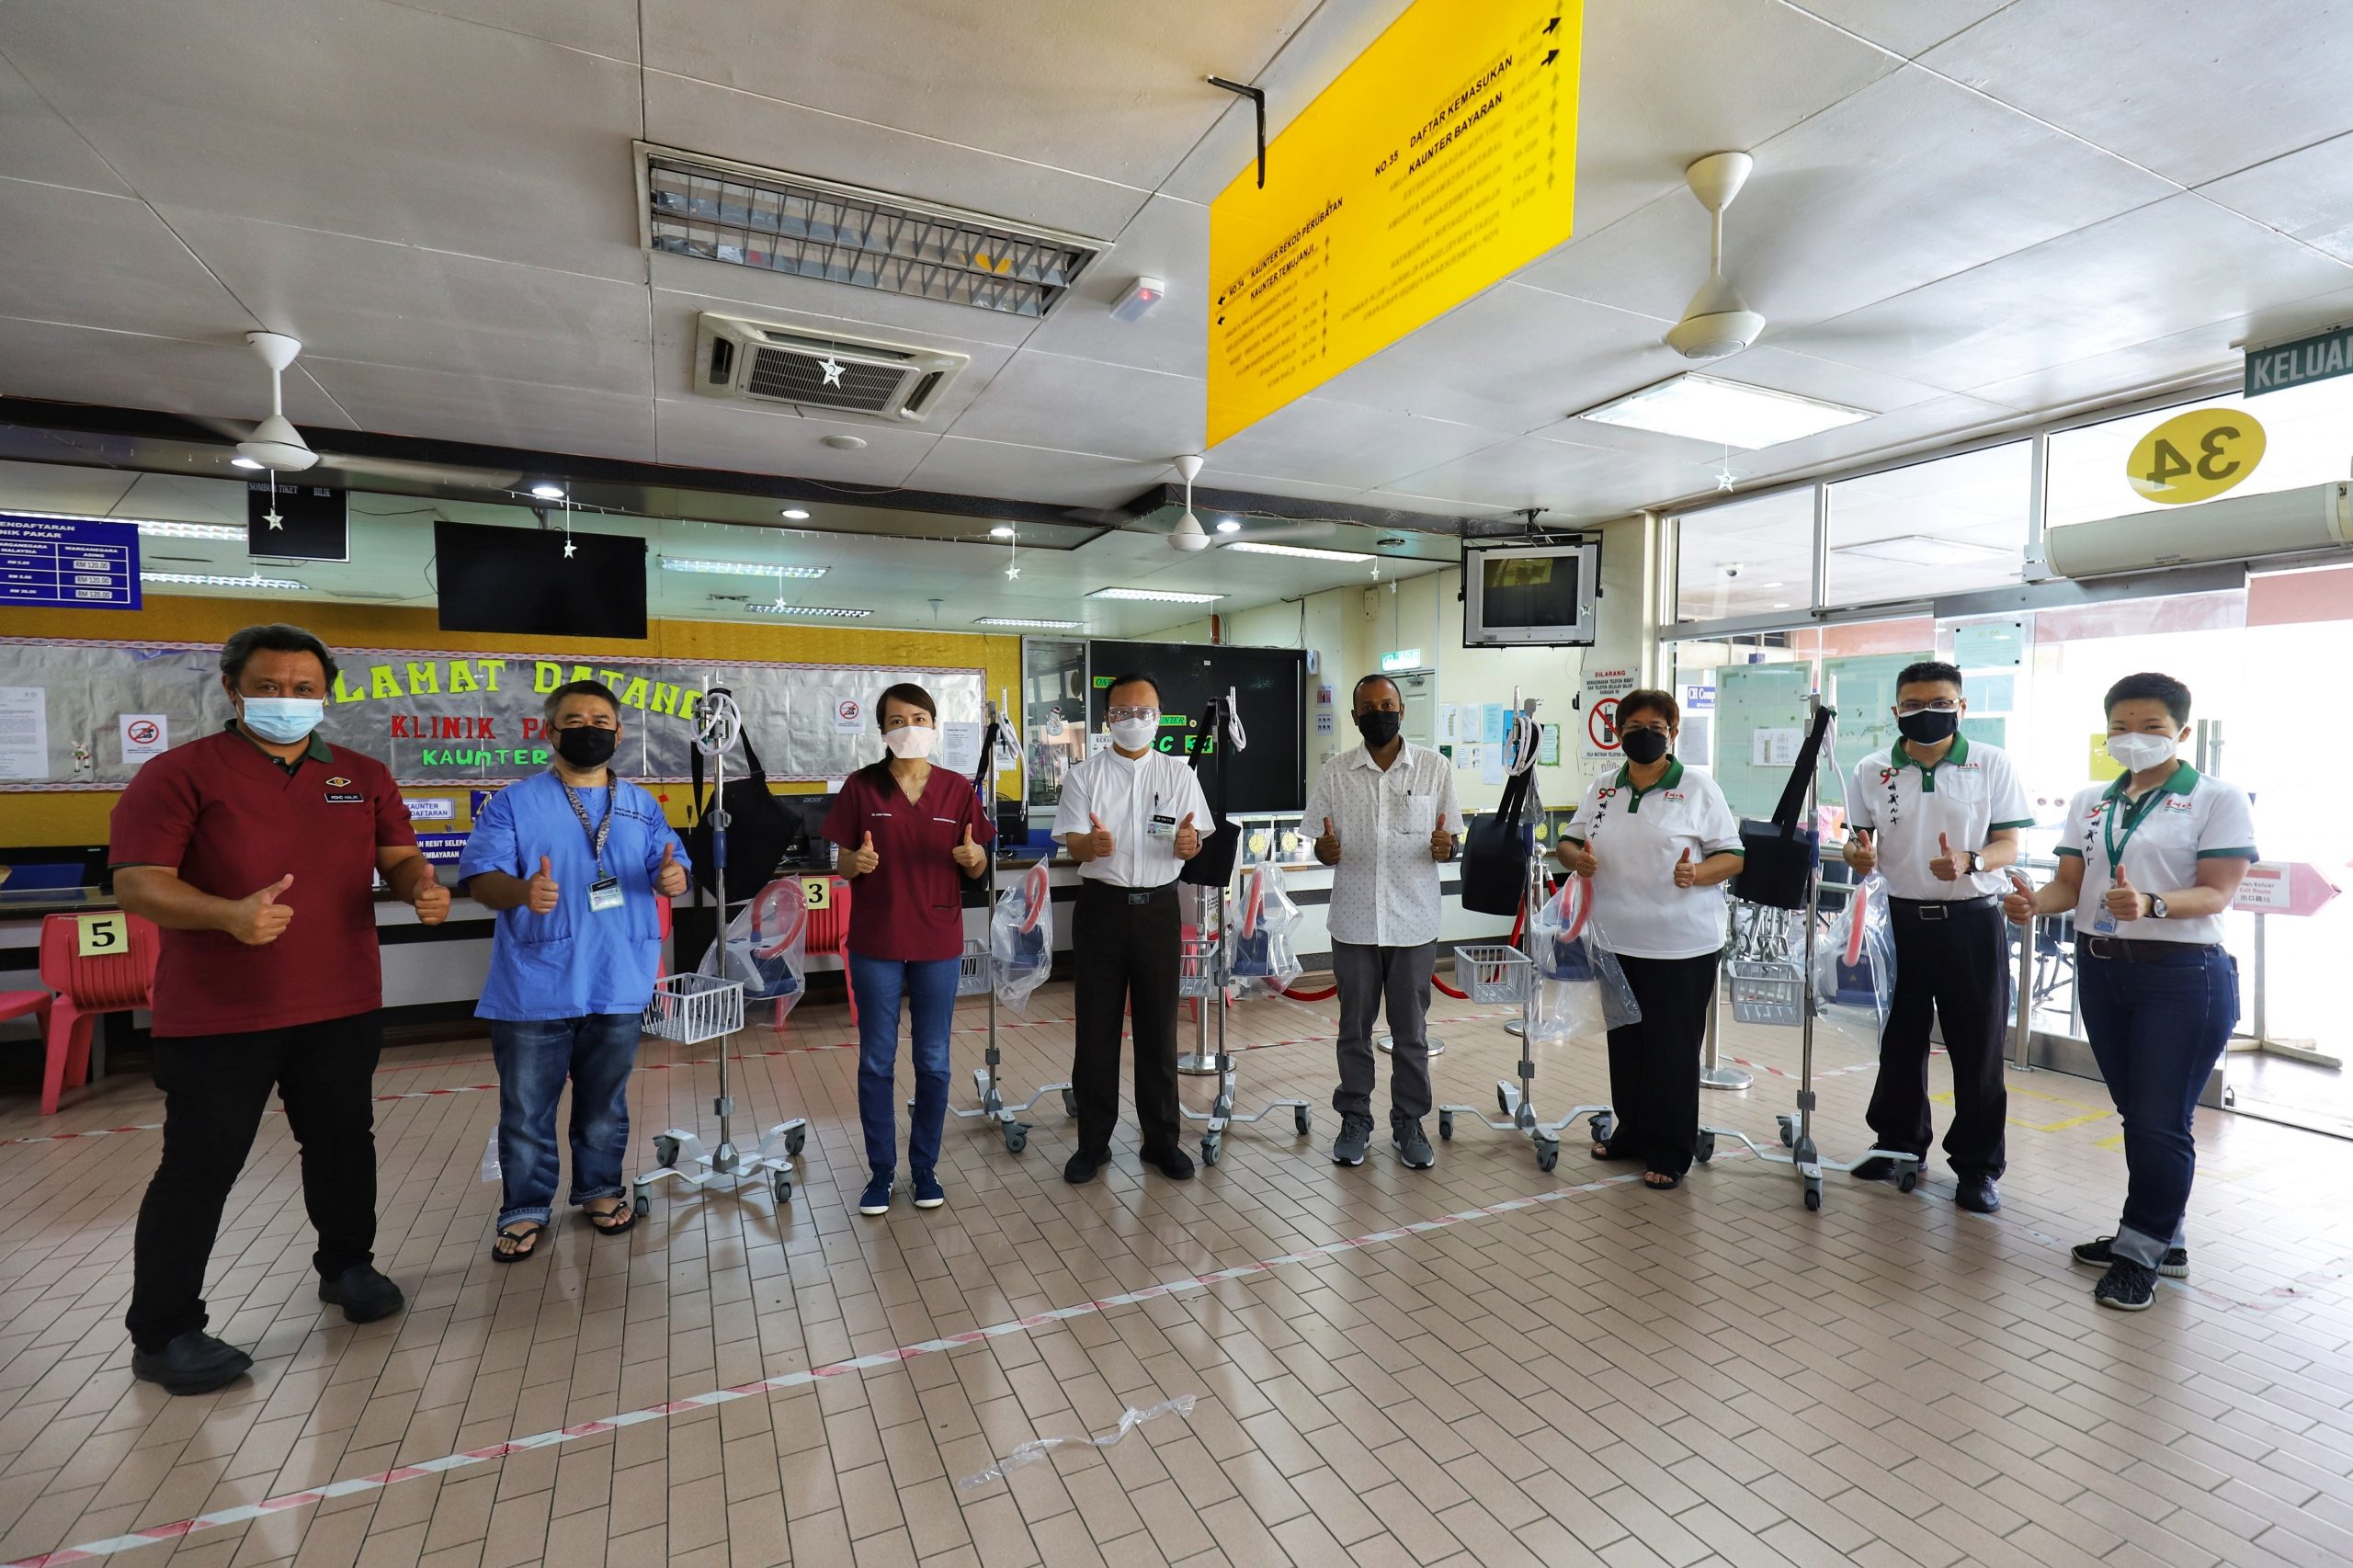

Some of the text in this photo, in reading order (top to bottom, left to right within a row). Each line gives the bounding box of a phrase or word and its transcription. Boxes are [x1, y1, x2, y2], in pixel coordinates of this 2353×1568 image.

[1375, 150, 1399, 176] NO.35
[1410, 110, 1446, 148] DAFTAR
[1448, 54, 1513, 117] KEMASUKAN
[1409, 91, 1503, 175] KAUNTER BAYARAN
[1251, 250, 1279, 279] KAUNTER
[1279, 232, 1302, 256] REKOD
[1302, 197, 1343, 238] PERUBATAN
[1251, 272, 1278, 300] KAUNTER
[1279, 244, 1314, 278] TEMUJANJI
[828, 364, 835, 378] 2
[278, 484, 298, 494] TIKET
[23, 530, 62, 539] PAKAR
[325, 660, 506, 705] LAMAT
[1688, 687, 1698, 699] CH
[391, 715, 495, 740] KLINIK
[423, 749, 548, 767] KAUNTER
[808, 883, 824, 903] 3
[91, 921, 116, 947] 5
